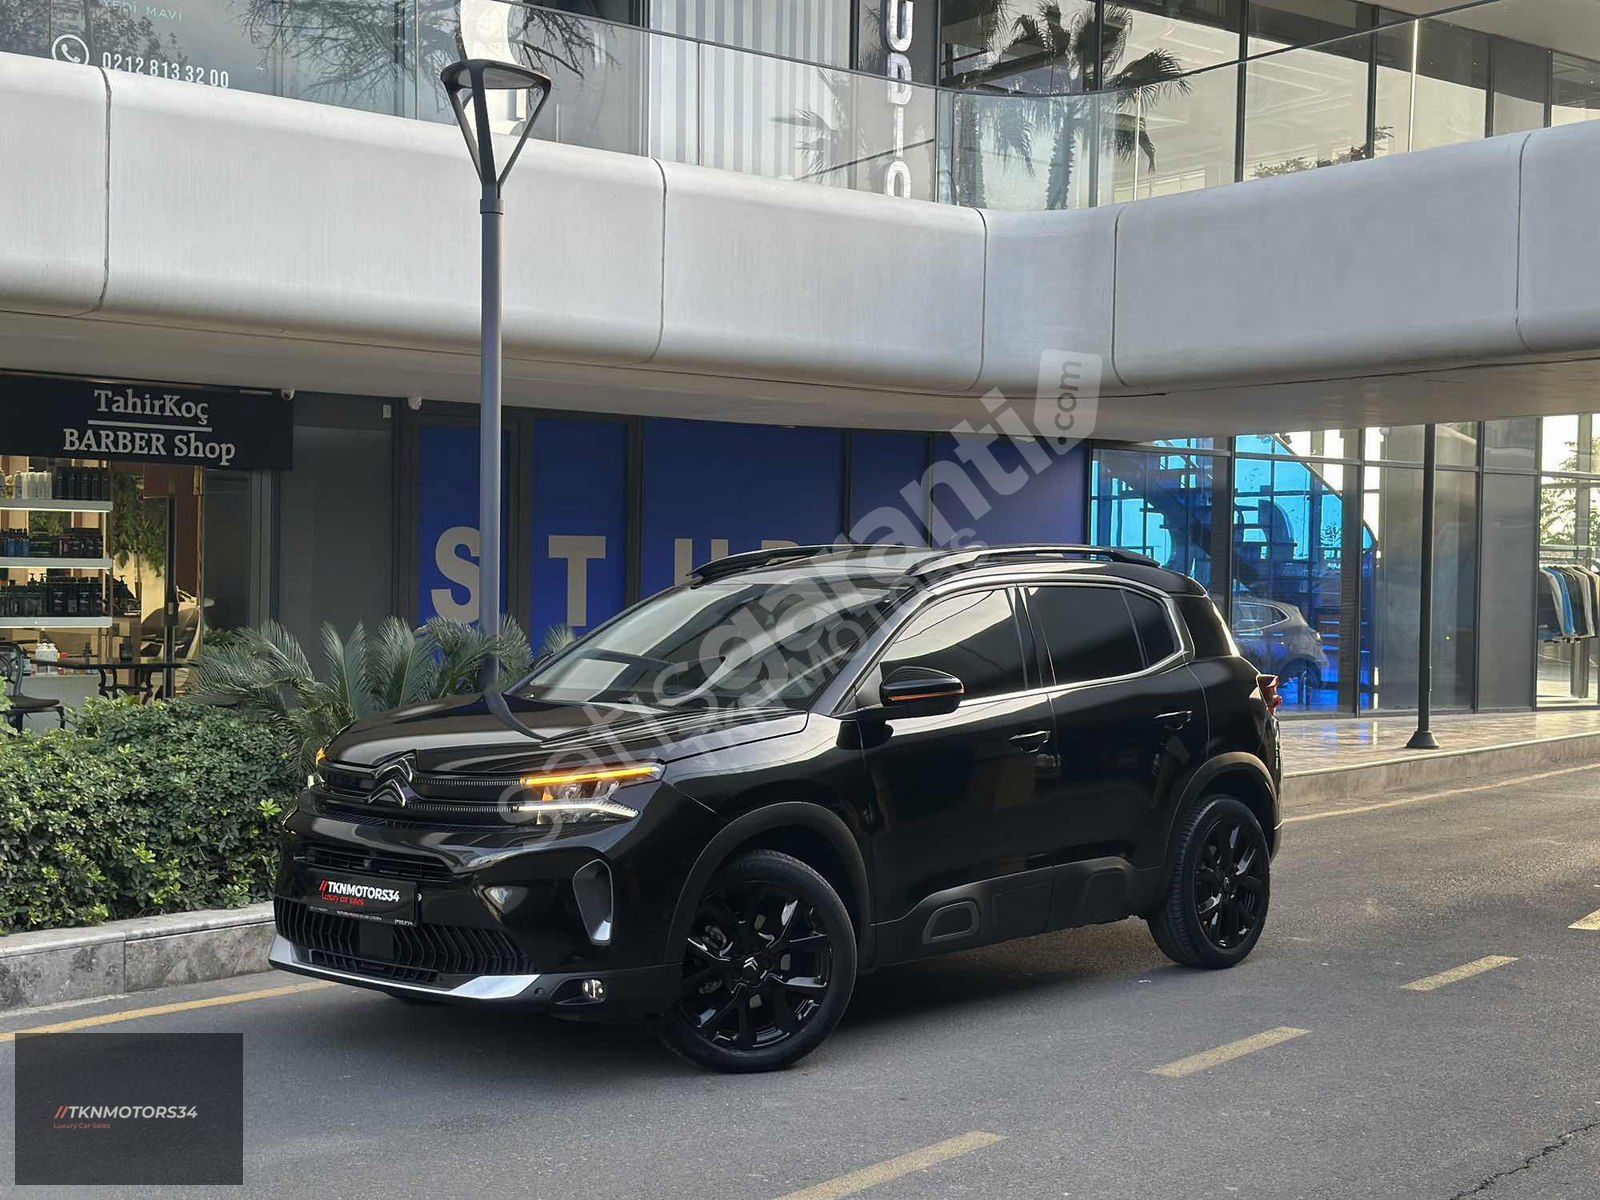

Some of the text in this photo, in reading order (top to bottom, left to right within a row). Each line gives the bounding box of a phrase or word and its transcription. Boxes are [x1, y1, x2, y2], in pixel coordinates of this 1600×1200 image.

[102, 52, 229, 87] 0212 813 32 00
[94, 388, 209, 425] TahirKoç
[63, 428, 236, 466] BARBER Shop
